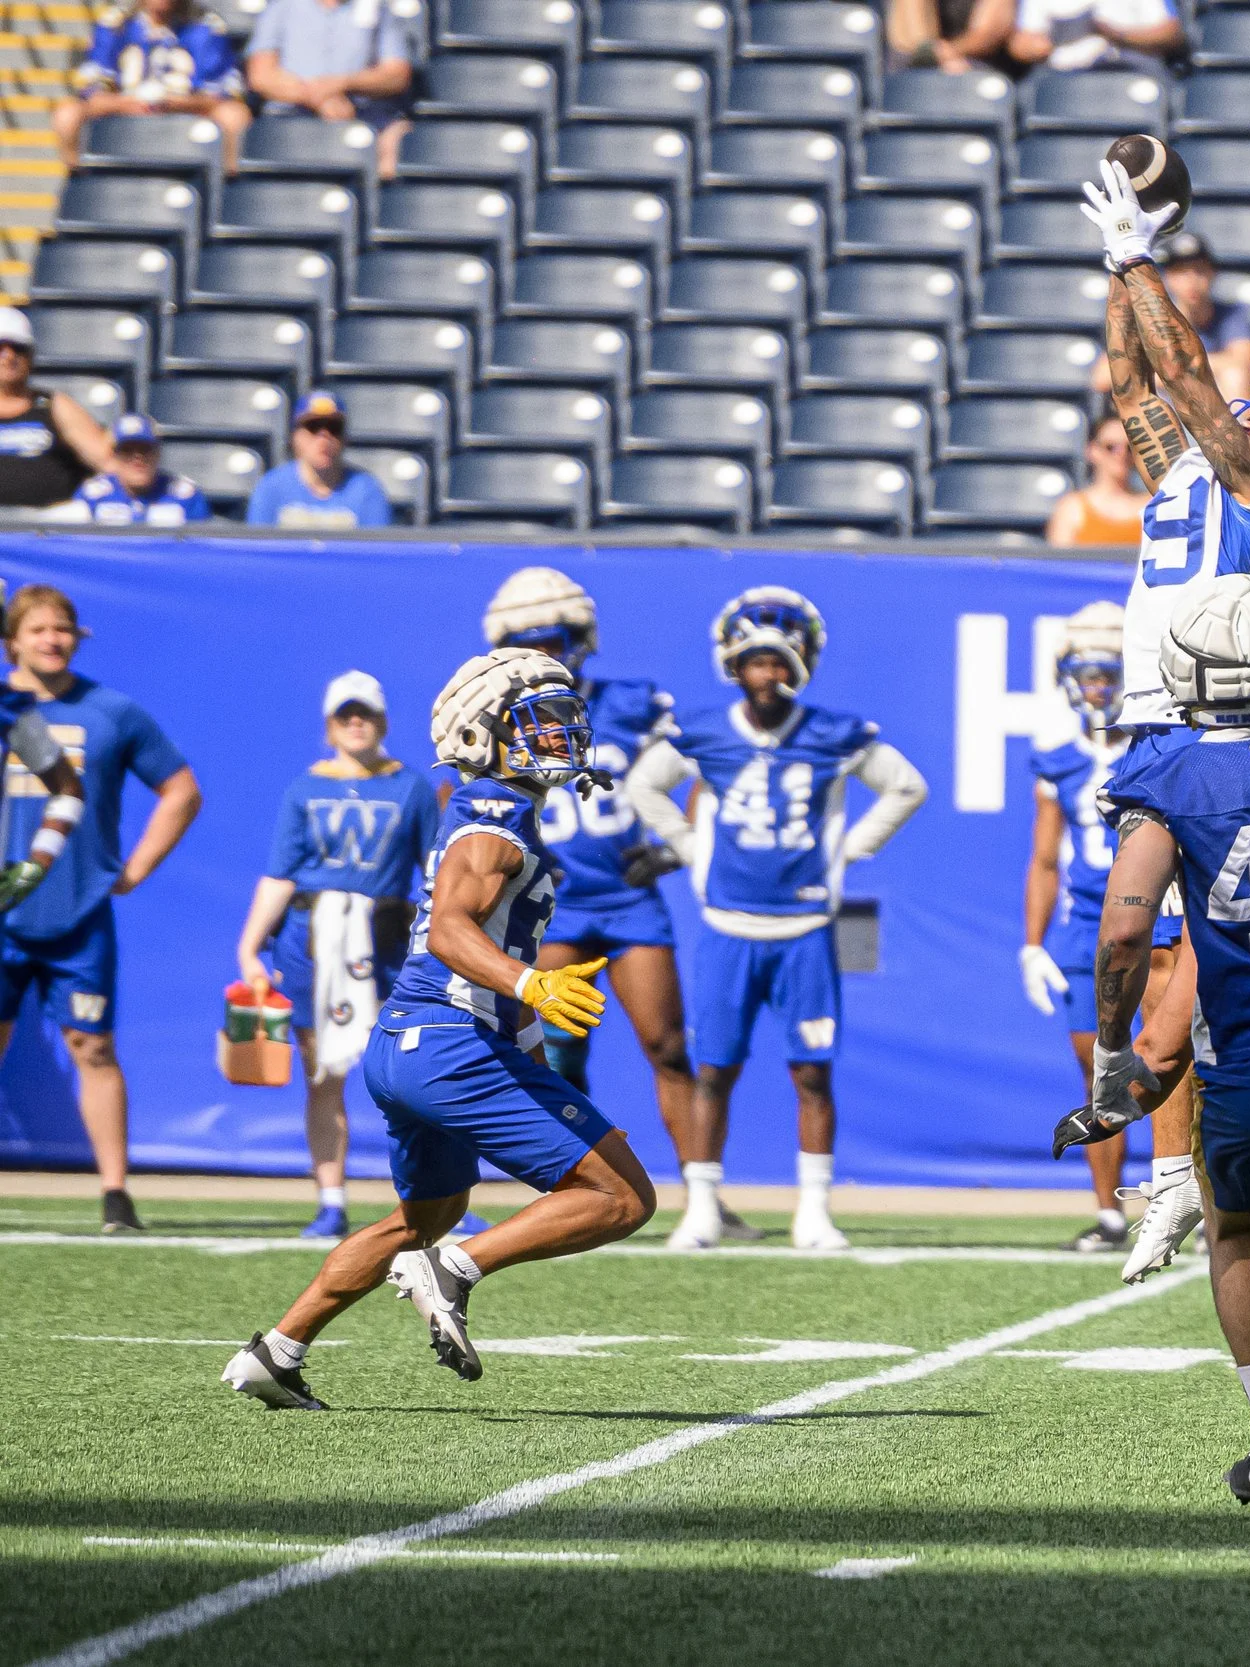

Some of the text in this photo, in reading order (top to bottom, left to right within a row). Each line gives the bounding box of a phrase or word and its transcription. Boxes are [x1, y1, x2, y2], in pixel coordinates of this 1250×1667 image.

[1117, 221, 1133, 232] CFL
[1125, 416, 1152, 446] SAY
[1143, 453, 1167, 481] AM
[1144, 406, 1172, 432] AM
[307, 798, 400, 870] W
[720, 760, 816, 850] 41
